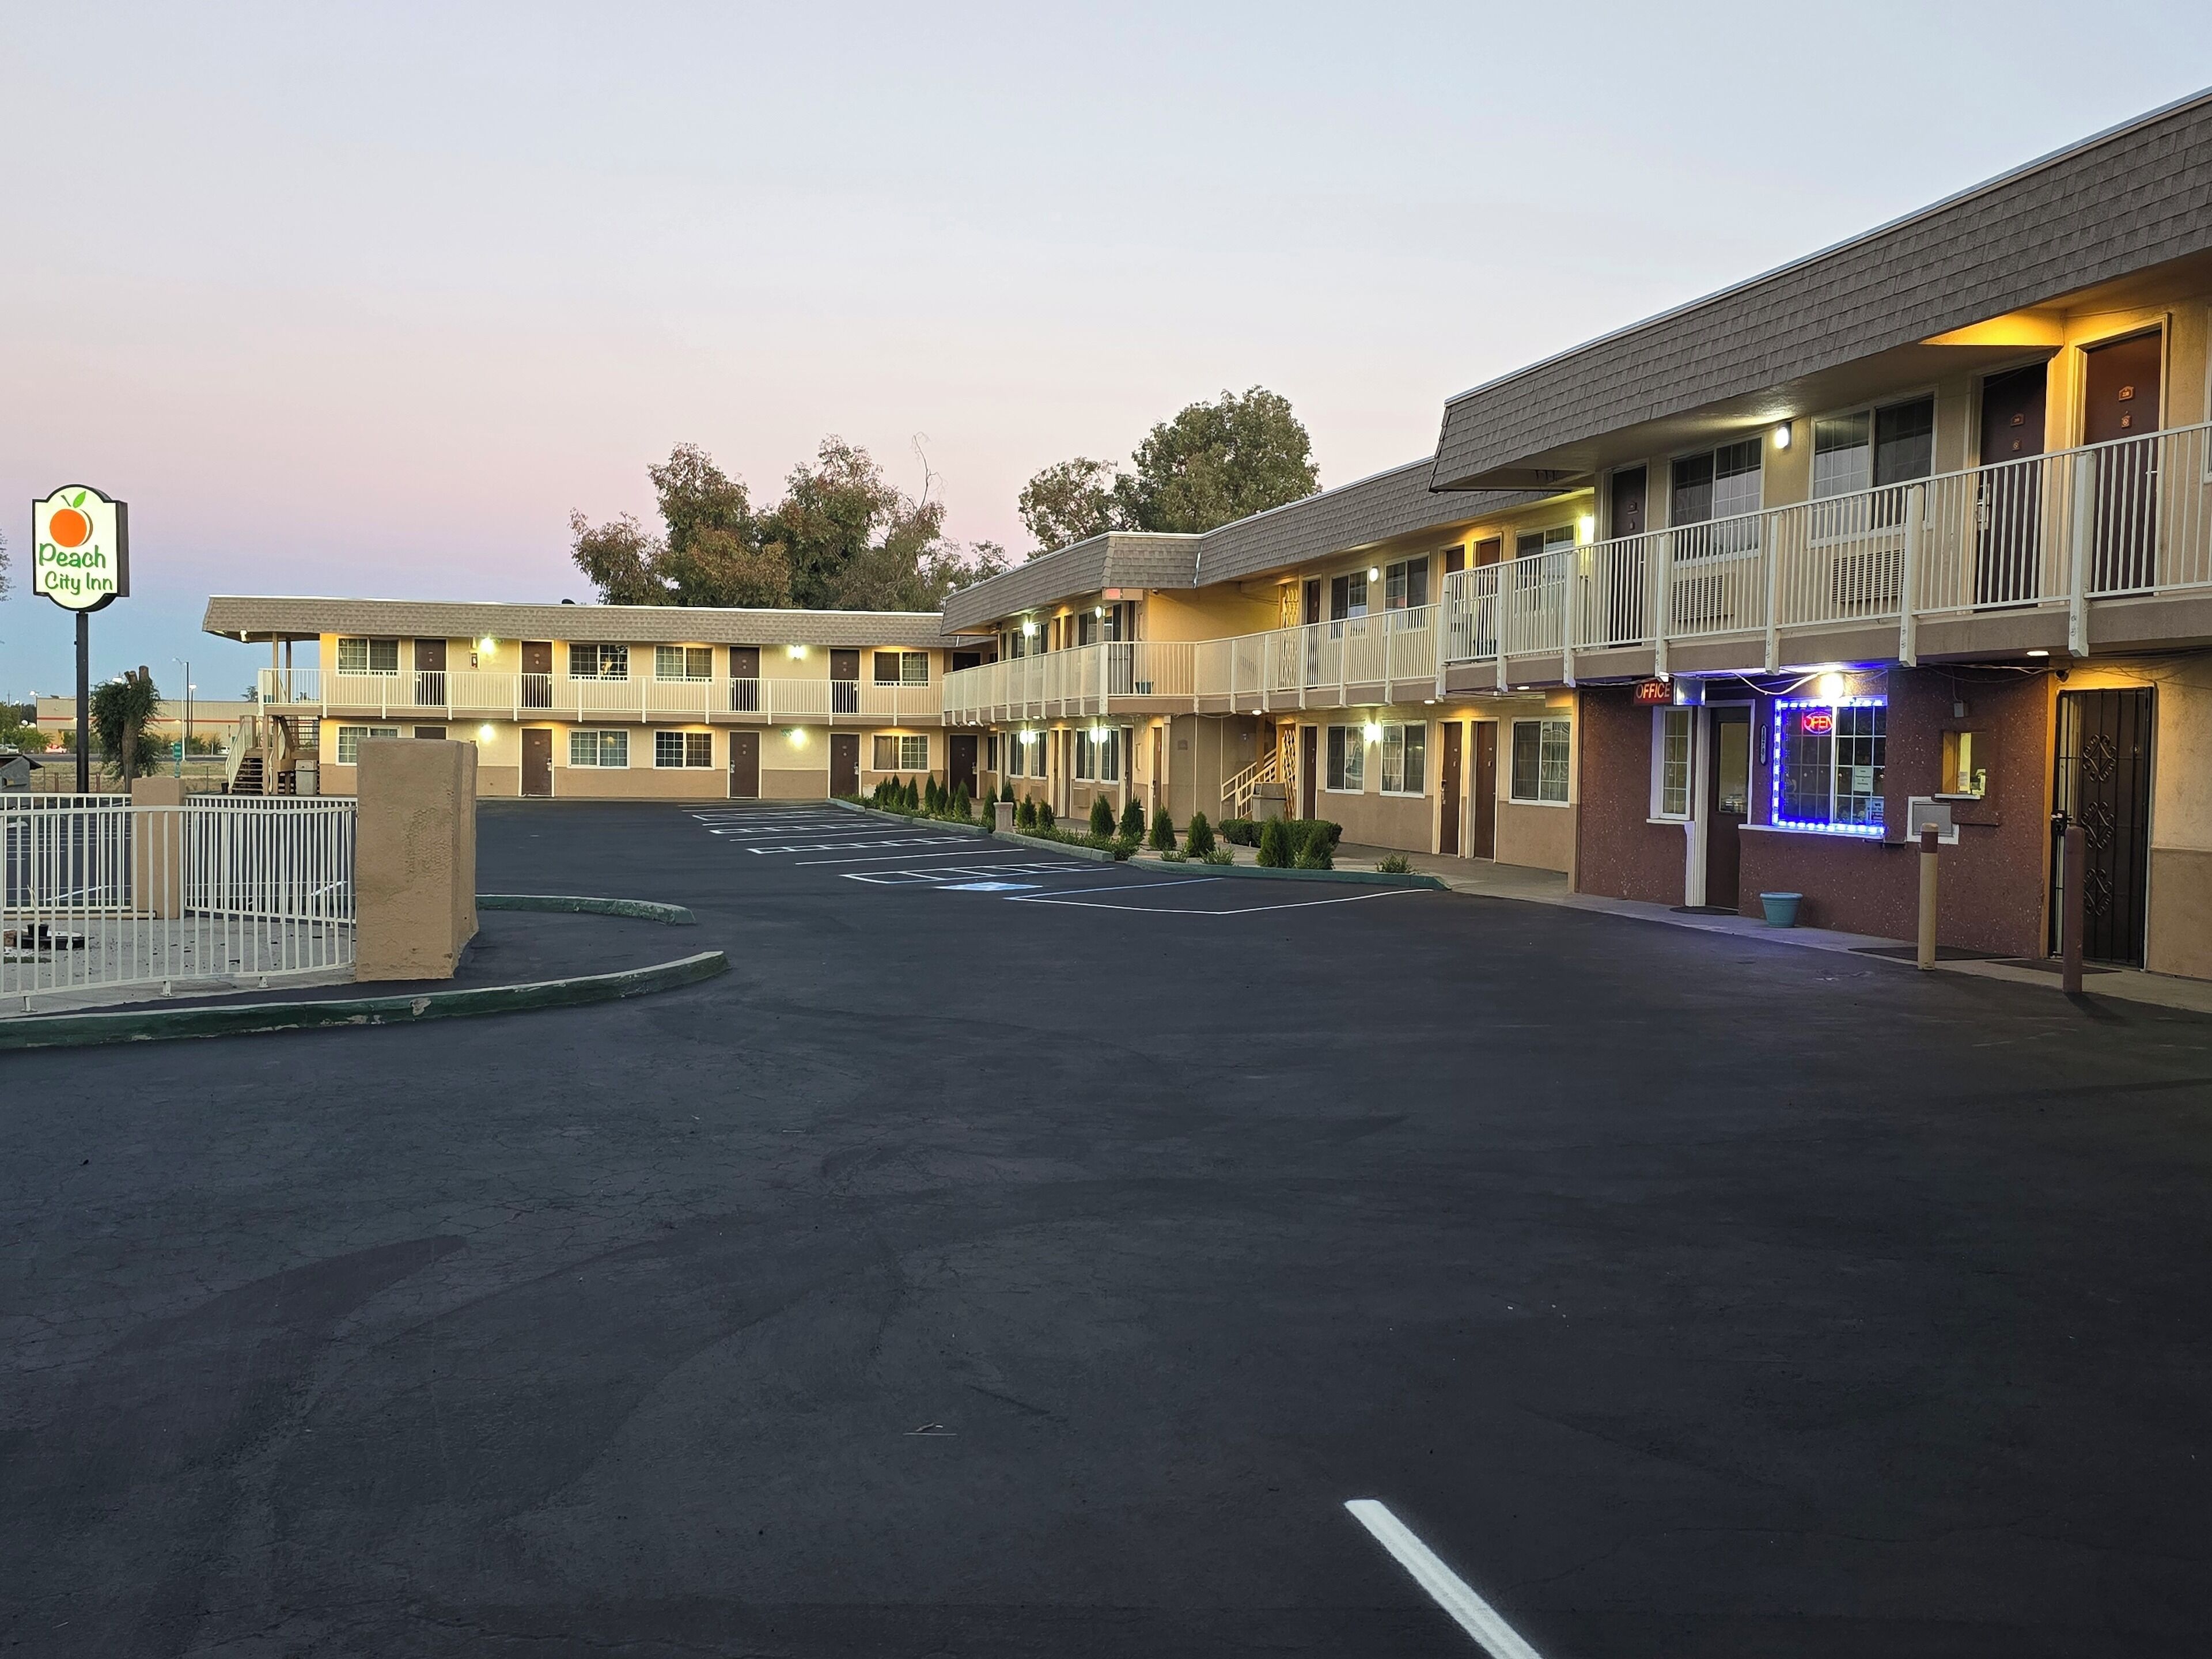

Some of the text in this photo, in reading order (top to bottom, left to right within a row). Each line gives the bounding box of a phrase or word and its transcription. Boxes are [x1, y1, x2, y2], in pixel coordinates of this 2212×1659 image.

[39, 543, 106, 569] Peach
[45, 571, 113, 596] City Inn
[1636, 683, 1671, 699] OFFICE
